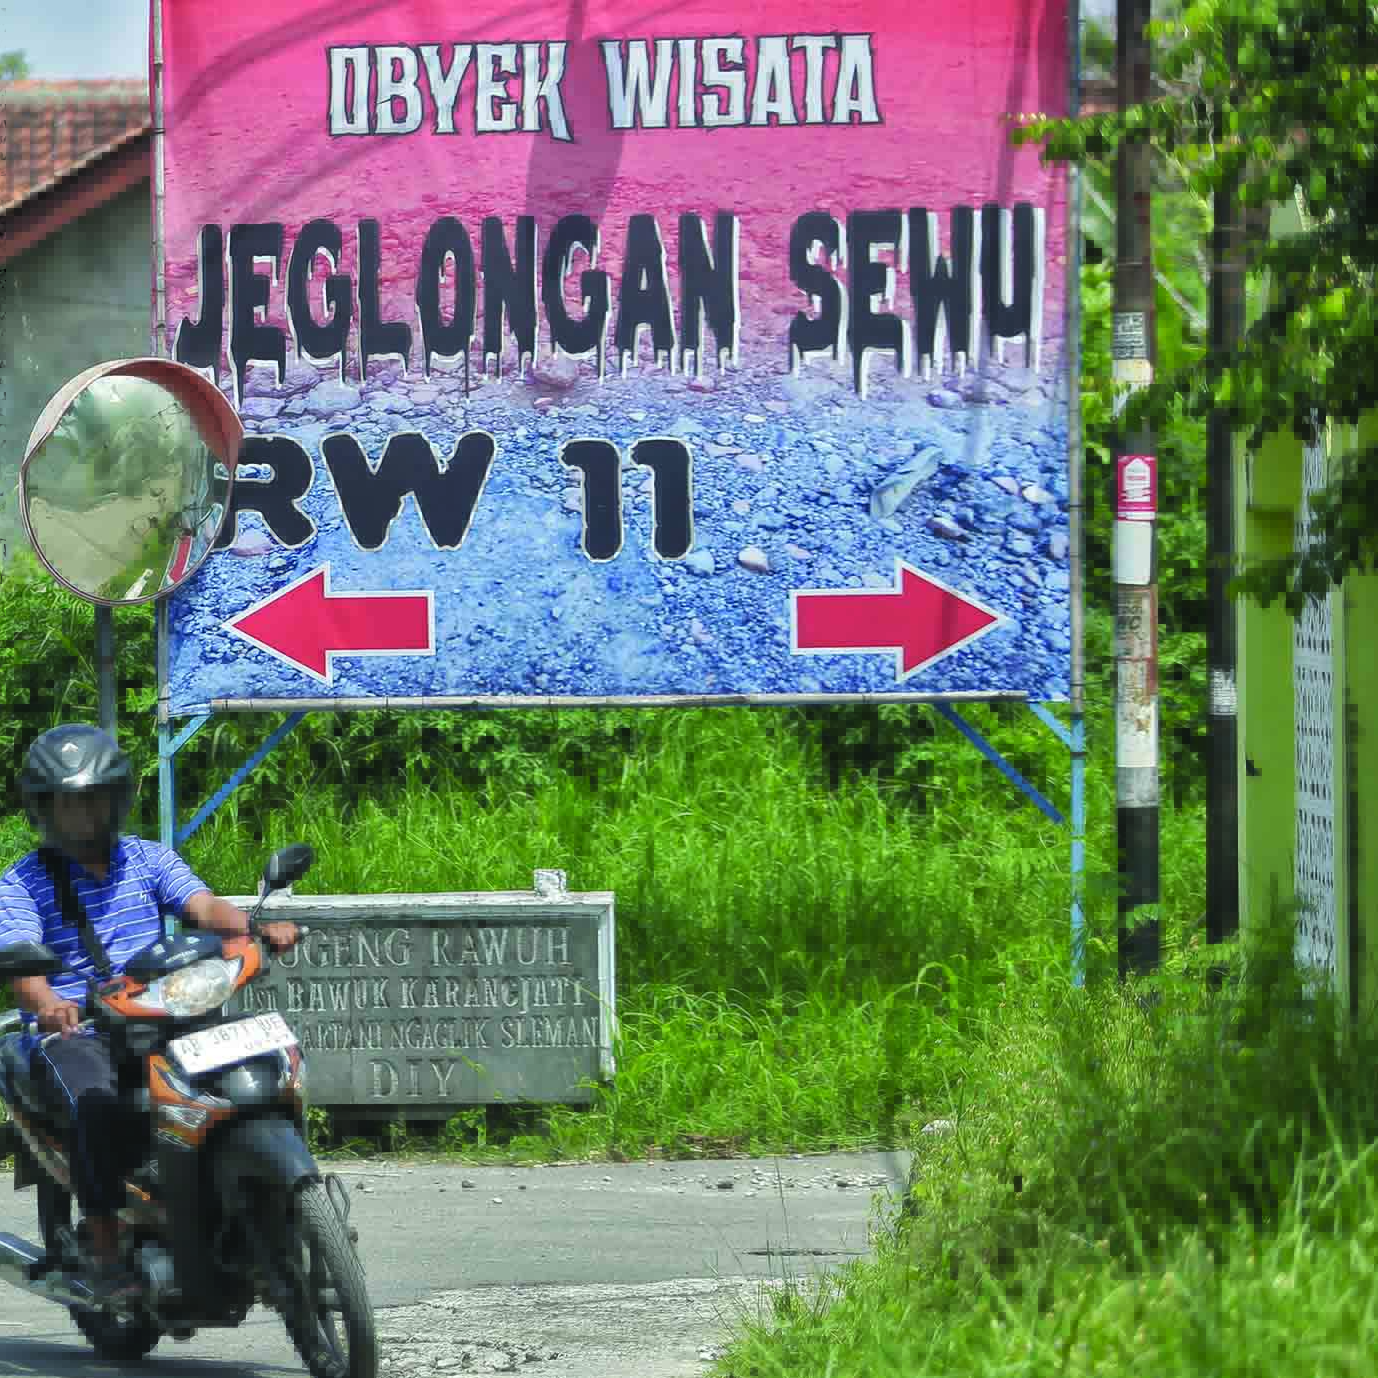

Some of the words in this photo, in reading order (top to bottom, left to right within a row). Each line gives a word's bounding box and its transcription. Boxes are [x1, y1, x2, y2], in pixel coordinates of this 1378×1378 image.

[325, 41, 573, 143] OBYEK
[597, 32, 883, 136] WISATA
[172, 212, 740, 402] JEGLONGAN
[789, 202, 1046, 398] SEWU
[212, 430, 497, 552] RW
[558, 438, 695, 562] 11
[432, 927, 573, 968] RAWUH
[286, 977, 390, 1013] BAWUK
[501, 1016, 599, 1048] SLEMAN
[369, 1056, 458, 1098] DIY
